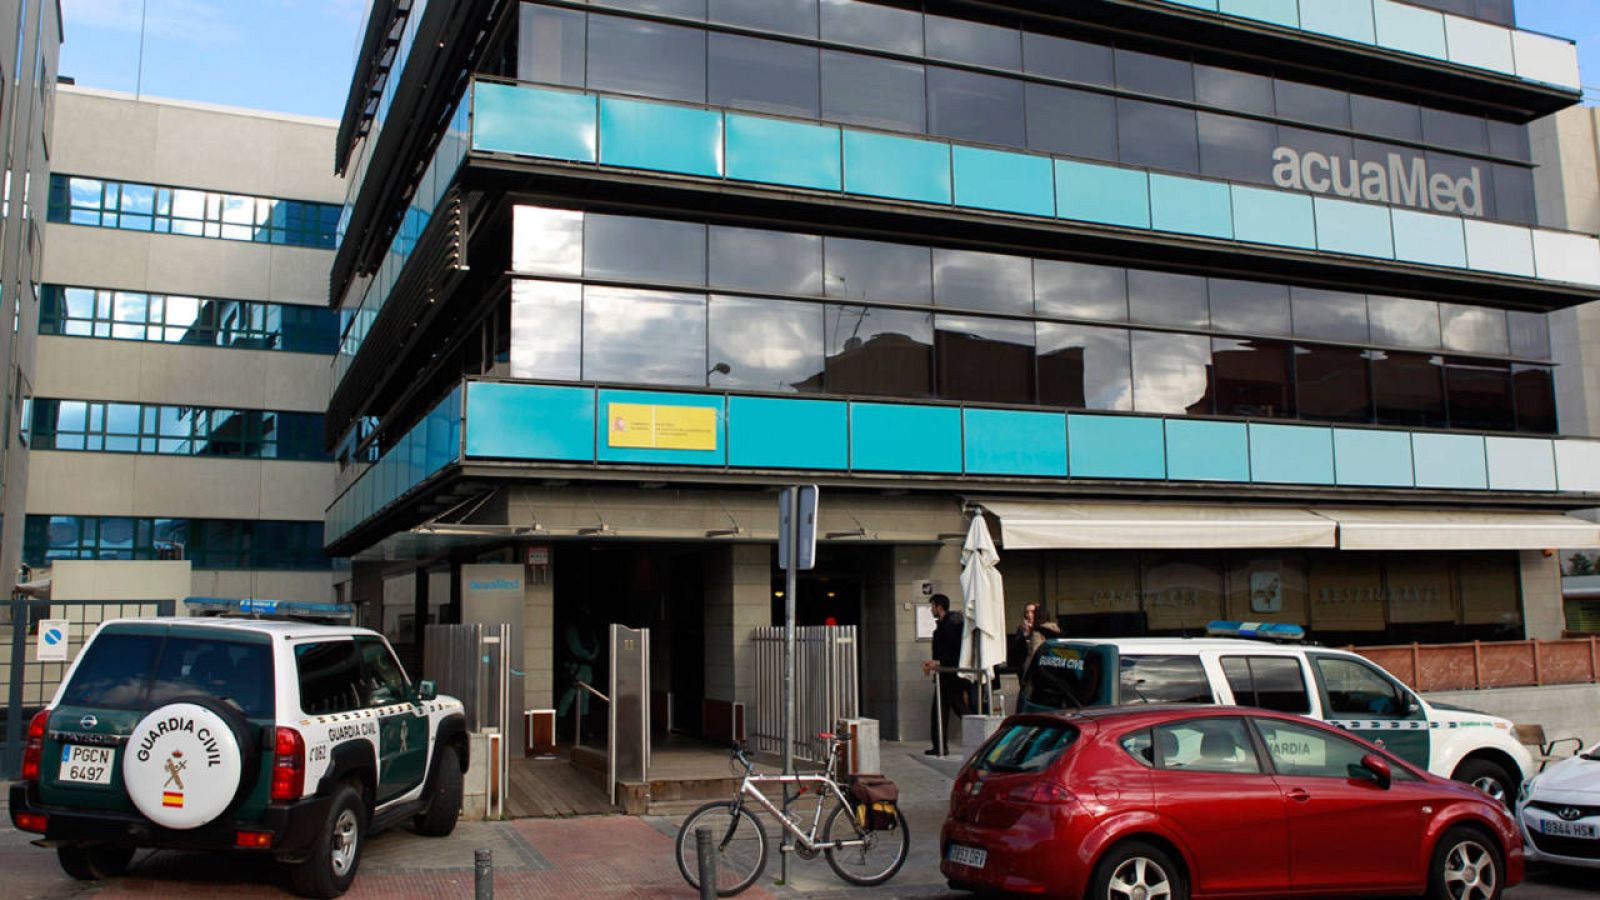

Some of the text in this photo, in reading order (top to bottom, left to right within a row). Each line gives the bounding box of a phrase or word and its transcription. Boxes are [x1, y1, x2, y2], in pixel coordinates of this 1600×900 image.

[1272, 146, 1484, 217] acuaMed
[1039, 655, 1085, 672] GUARDIA CIVIL
[328, 722, 377, 742] GUARDIA CIVIL
[137, 717, 221, 768] GUARDIA CIVIL
[72, 747, 110, 764] PGCN
[69, 765, 104, 781] 6497
